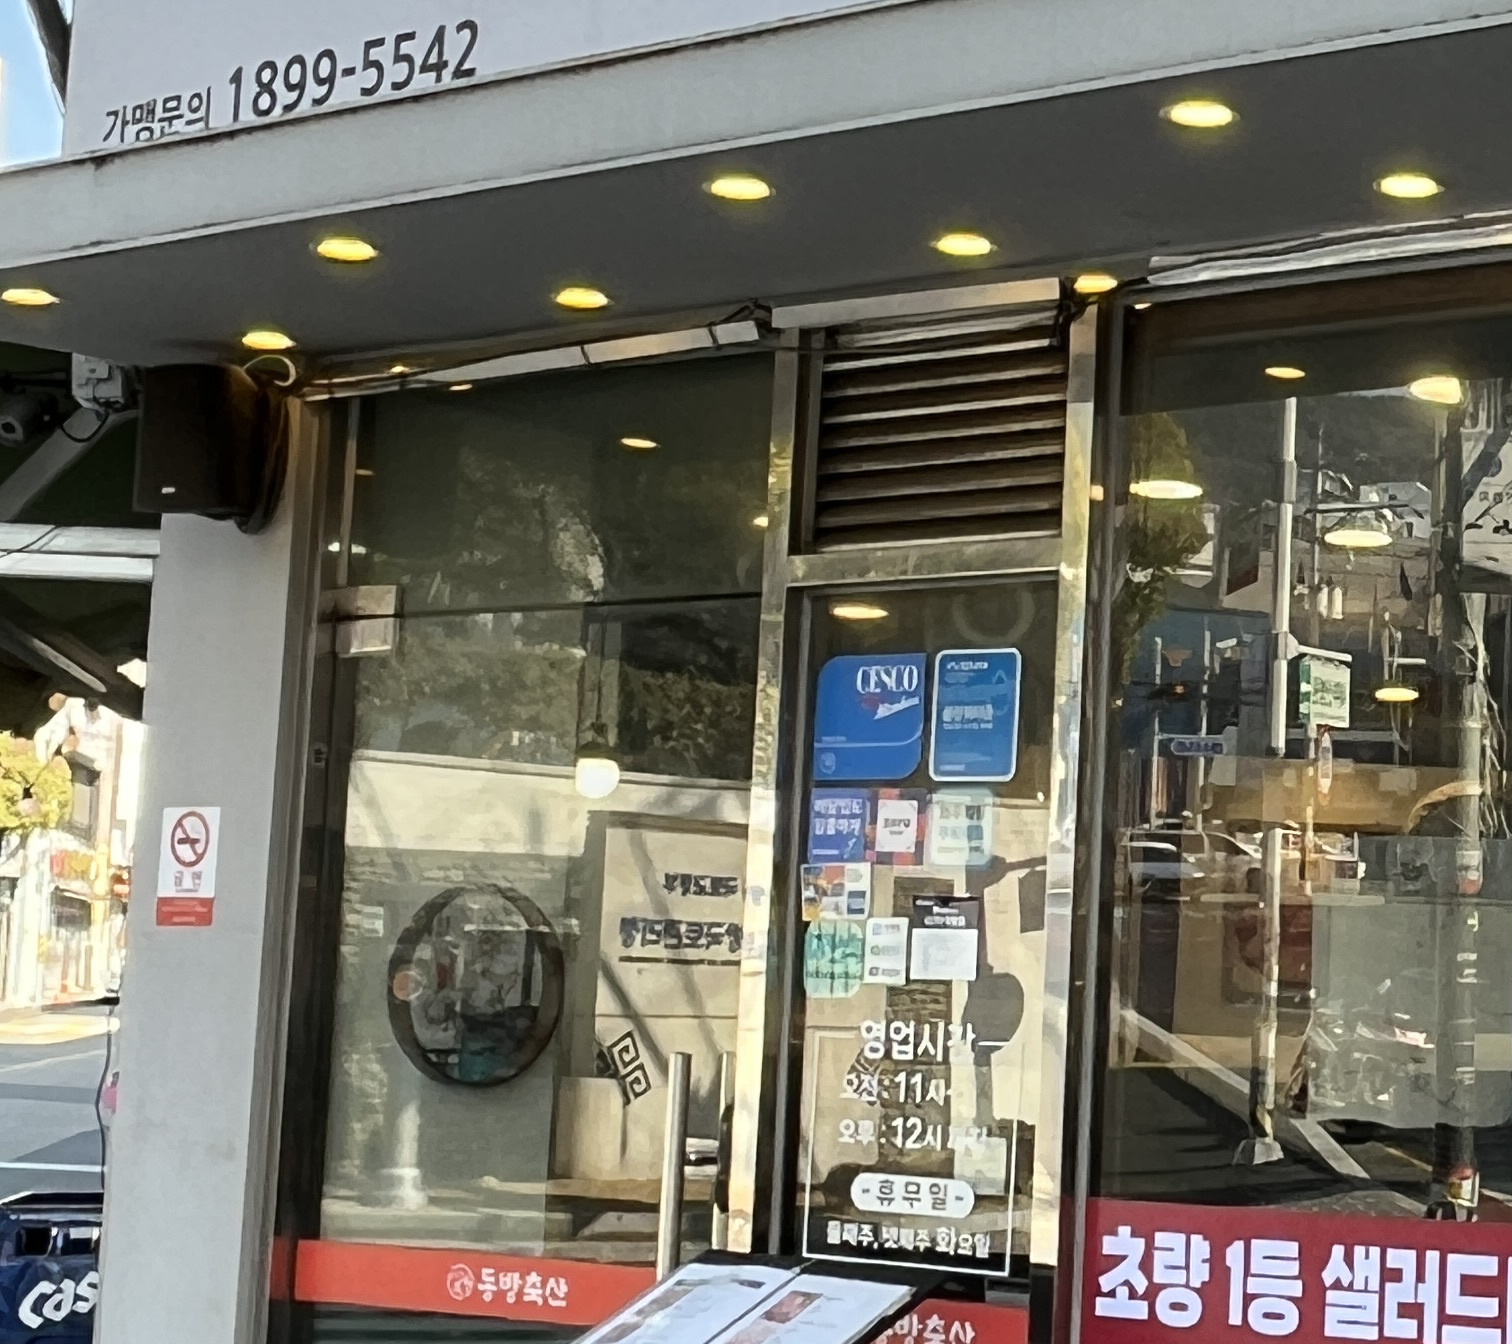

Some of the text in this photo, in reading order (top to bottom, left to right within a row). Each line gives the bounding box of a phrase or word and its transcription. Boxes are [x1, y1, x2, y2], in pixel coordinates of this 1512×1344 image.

[102, 19, 480, 143] 가맹문의 1899-5542
[856, 664, 918, 694] CESCO
[478, 1267, 569, 1308] 동방축산
[1094, 1224, 1211, 1329] 초량
[1225, 1239, 1303, 1336] 1등
